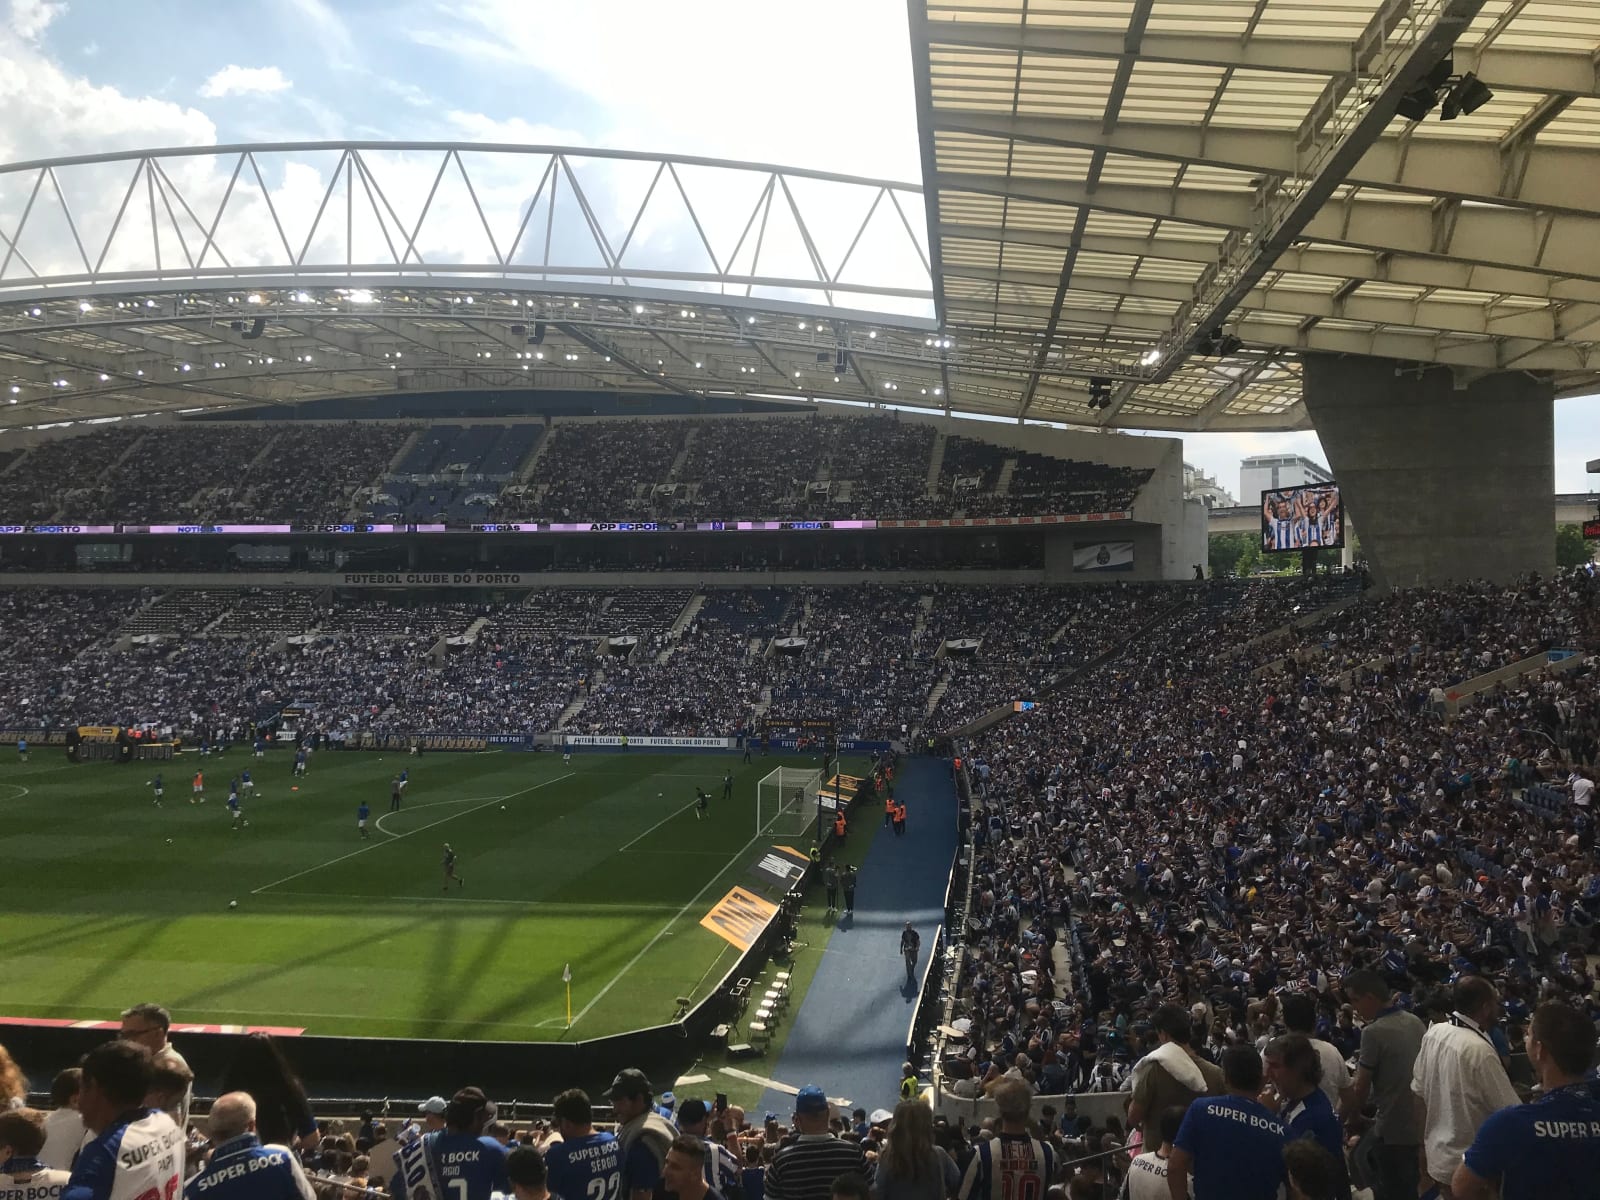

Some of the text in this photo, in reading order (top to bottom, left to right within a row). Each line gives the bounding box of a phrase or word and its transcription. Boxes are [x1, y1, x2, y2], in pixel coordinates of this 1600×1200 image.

[591, 523, 616, 531] APP
[345, 574, 521, 584] FUTEBOL CLUBE DO PORTO
[1208, 1104, 1285, 1137] SUPER BOCK
[1534, 1120, 1589, 1138] SUPER
[121, 1139, 163, 1171] SUPER
[448, 1151, 480, 1164] BOCK
[568, 1146, 601, 1165] SUPER
[198, 1163, 247, 1192] SUPER
[248, 1153, 286, 1173] BOCK
